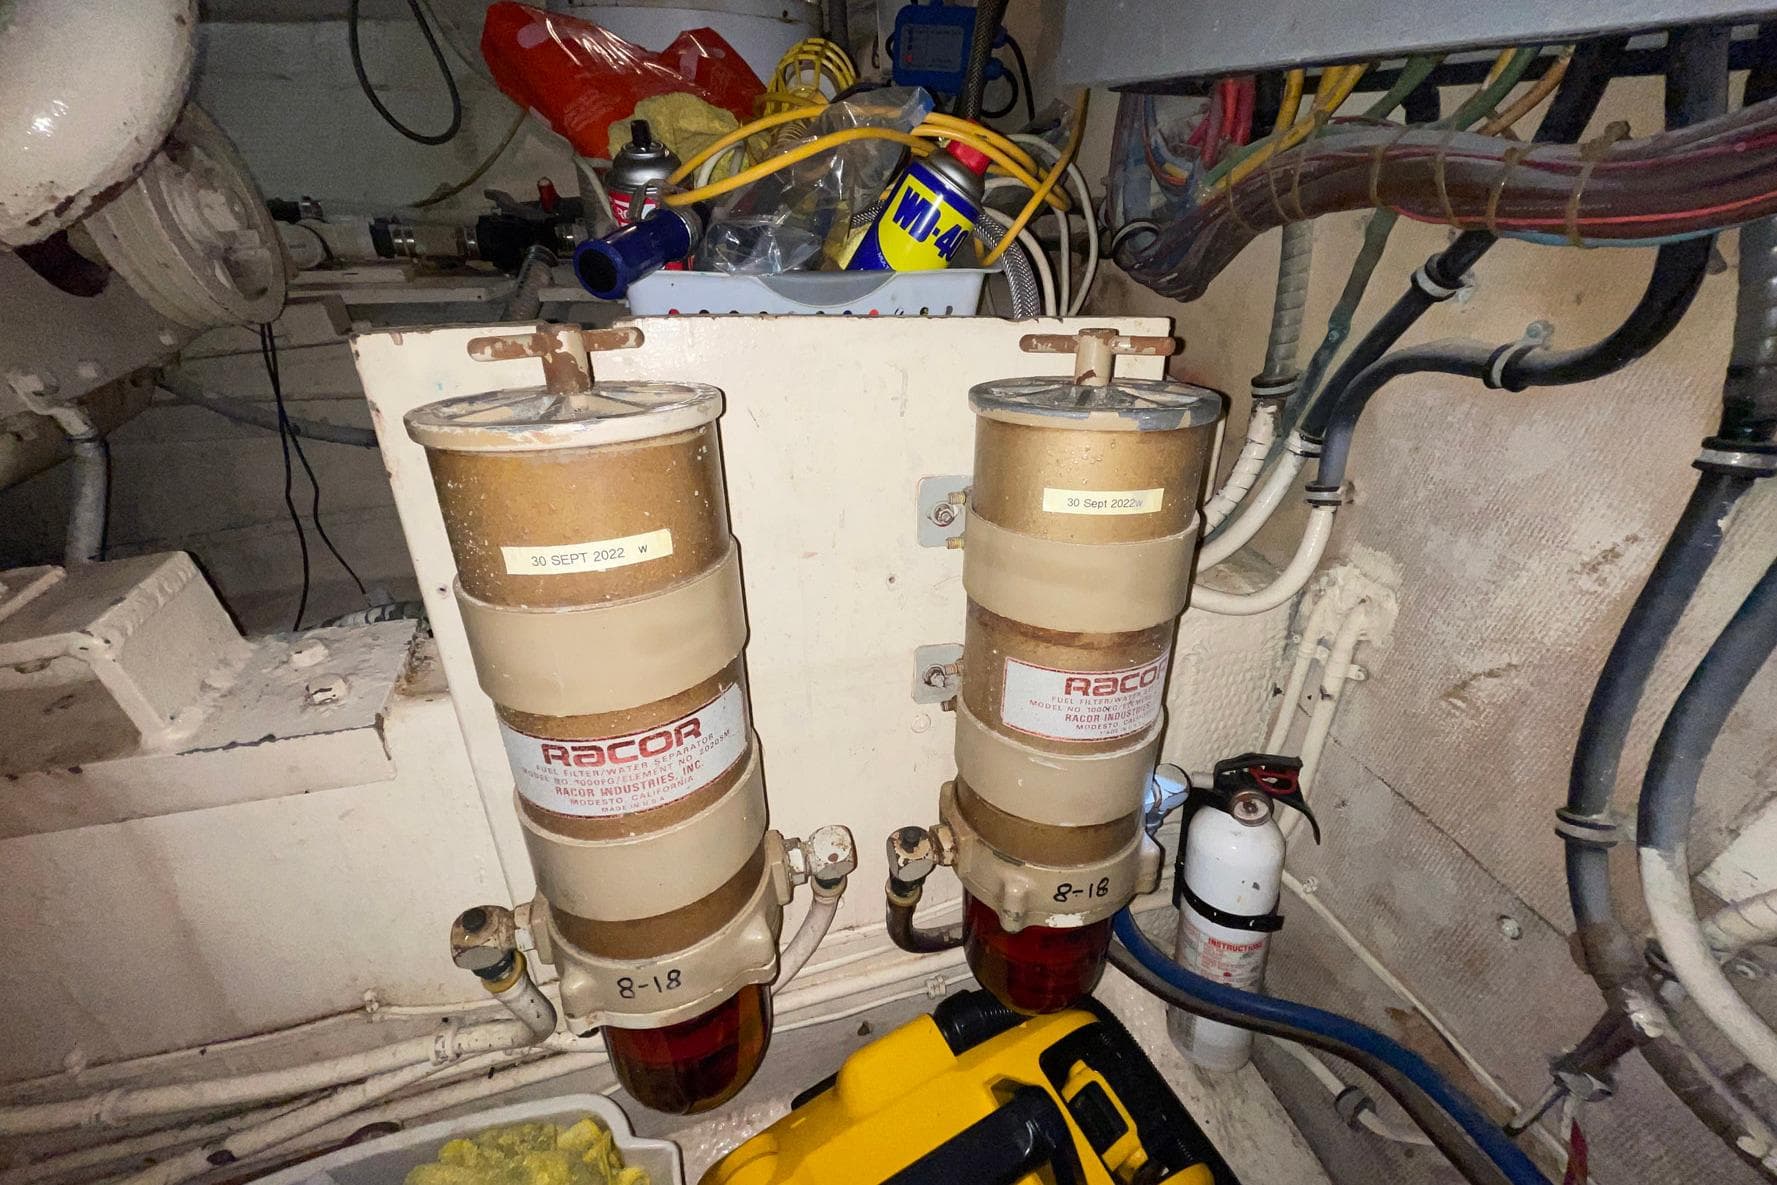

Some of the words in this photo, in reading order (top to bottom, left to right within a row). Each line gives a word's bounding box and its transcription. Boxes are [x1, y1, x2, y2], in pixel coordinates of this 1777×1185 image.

[892, 186, 970, 262] WD-40
[1066, 498, 1080, 508] 30
[1083, 498, 1107, 509] Sept
[531, 555, 547, 567] 30
[550, 552, 588, 567] SEPT
[593, 547, 625, 562] 2022
[1028, 699, 1063, 712] MODEL
[1065, 713, 1100, 723] RACOR
[536, 764, 559, 776] FUEL
[654, 732, 714, 765] SEPARATOR
[555, 786, 595, 798] RACOR
[570, 797, 624, 806] MODESTO
[632, 775, 694, 801] CALIFORNIA
[1053, 877, 1110, 902] 8-18
[617, 969, 682, 999] 8-18
